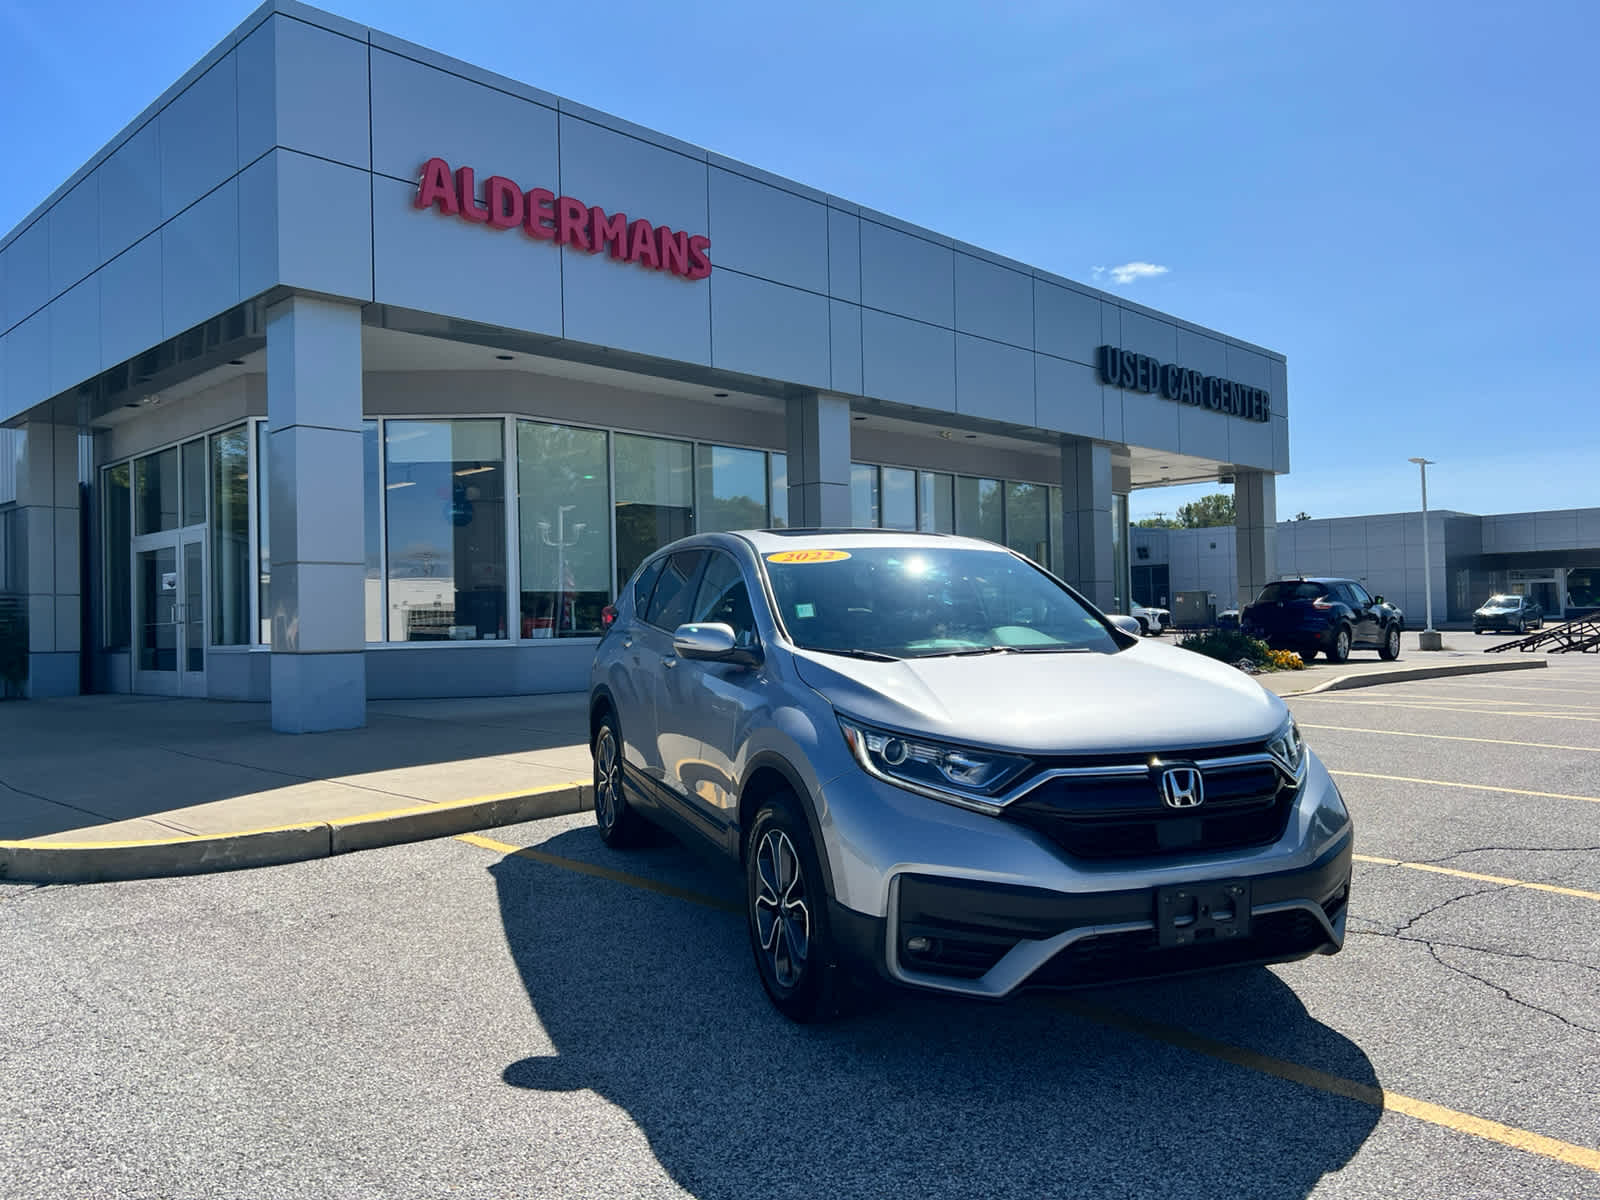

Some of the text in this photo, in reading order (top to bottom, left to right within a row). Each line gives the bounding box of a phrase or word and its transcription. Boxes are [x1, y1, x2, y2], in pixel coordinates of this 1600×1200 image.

[413, 157, 712, 281] ALDERMANS
[1097, 345, 1271, 423] USED CAR CENTER
[782, 551, 836, 562] 2022
